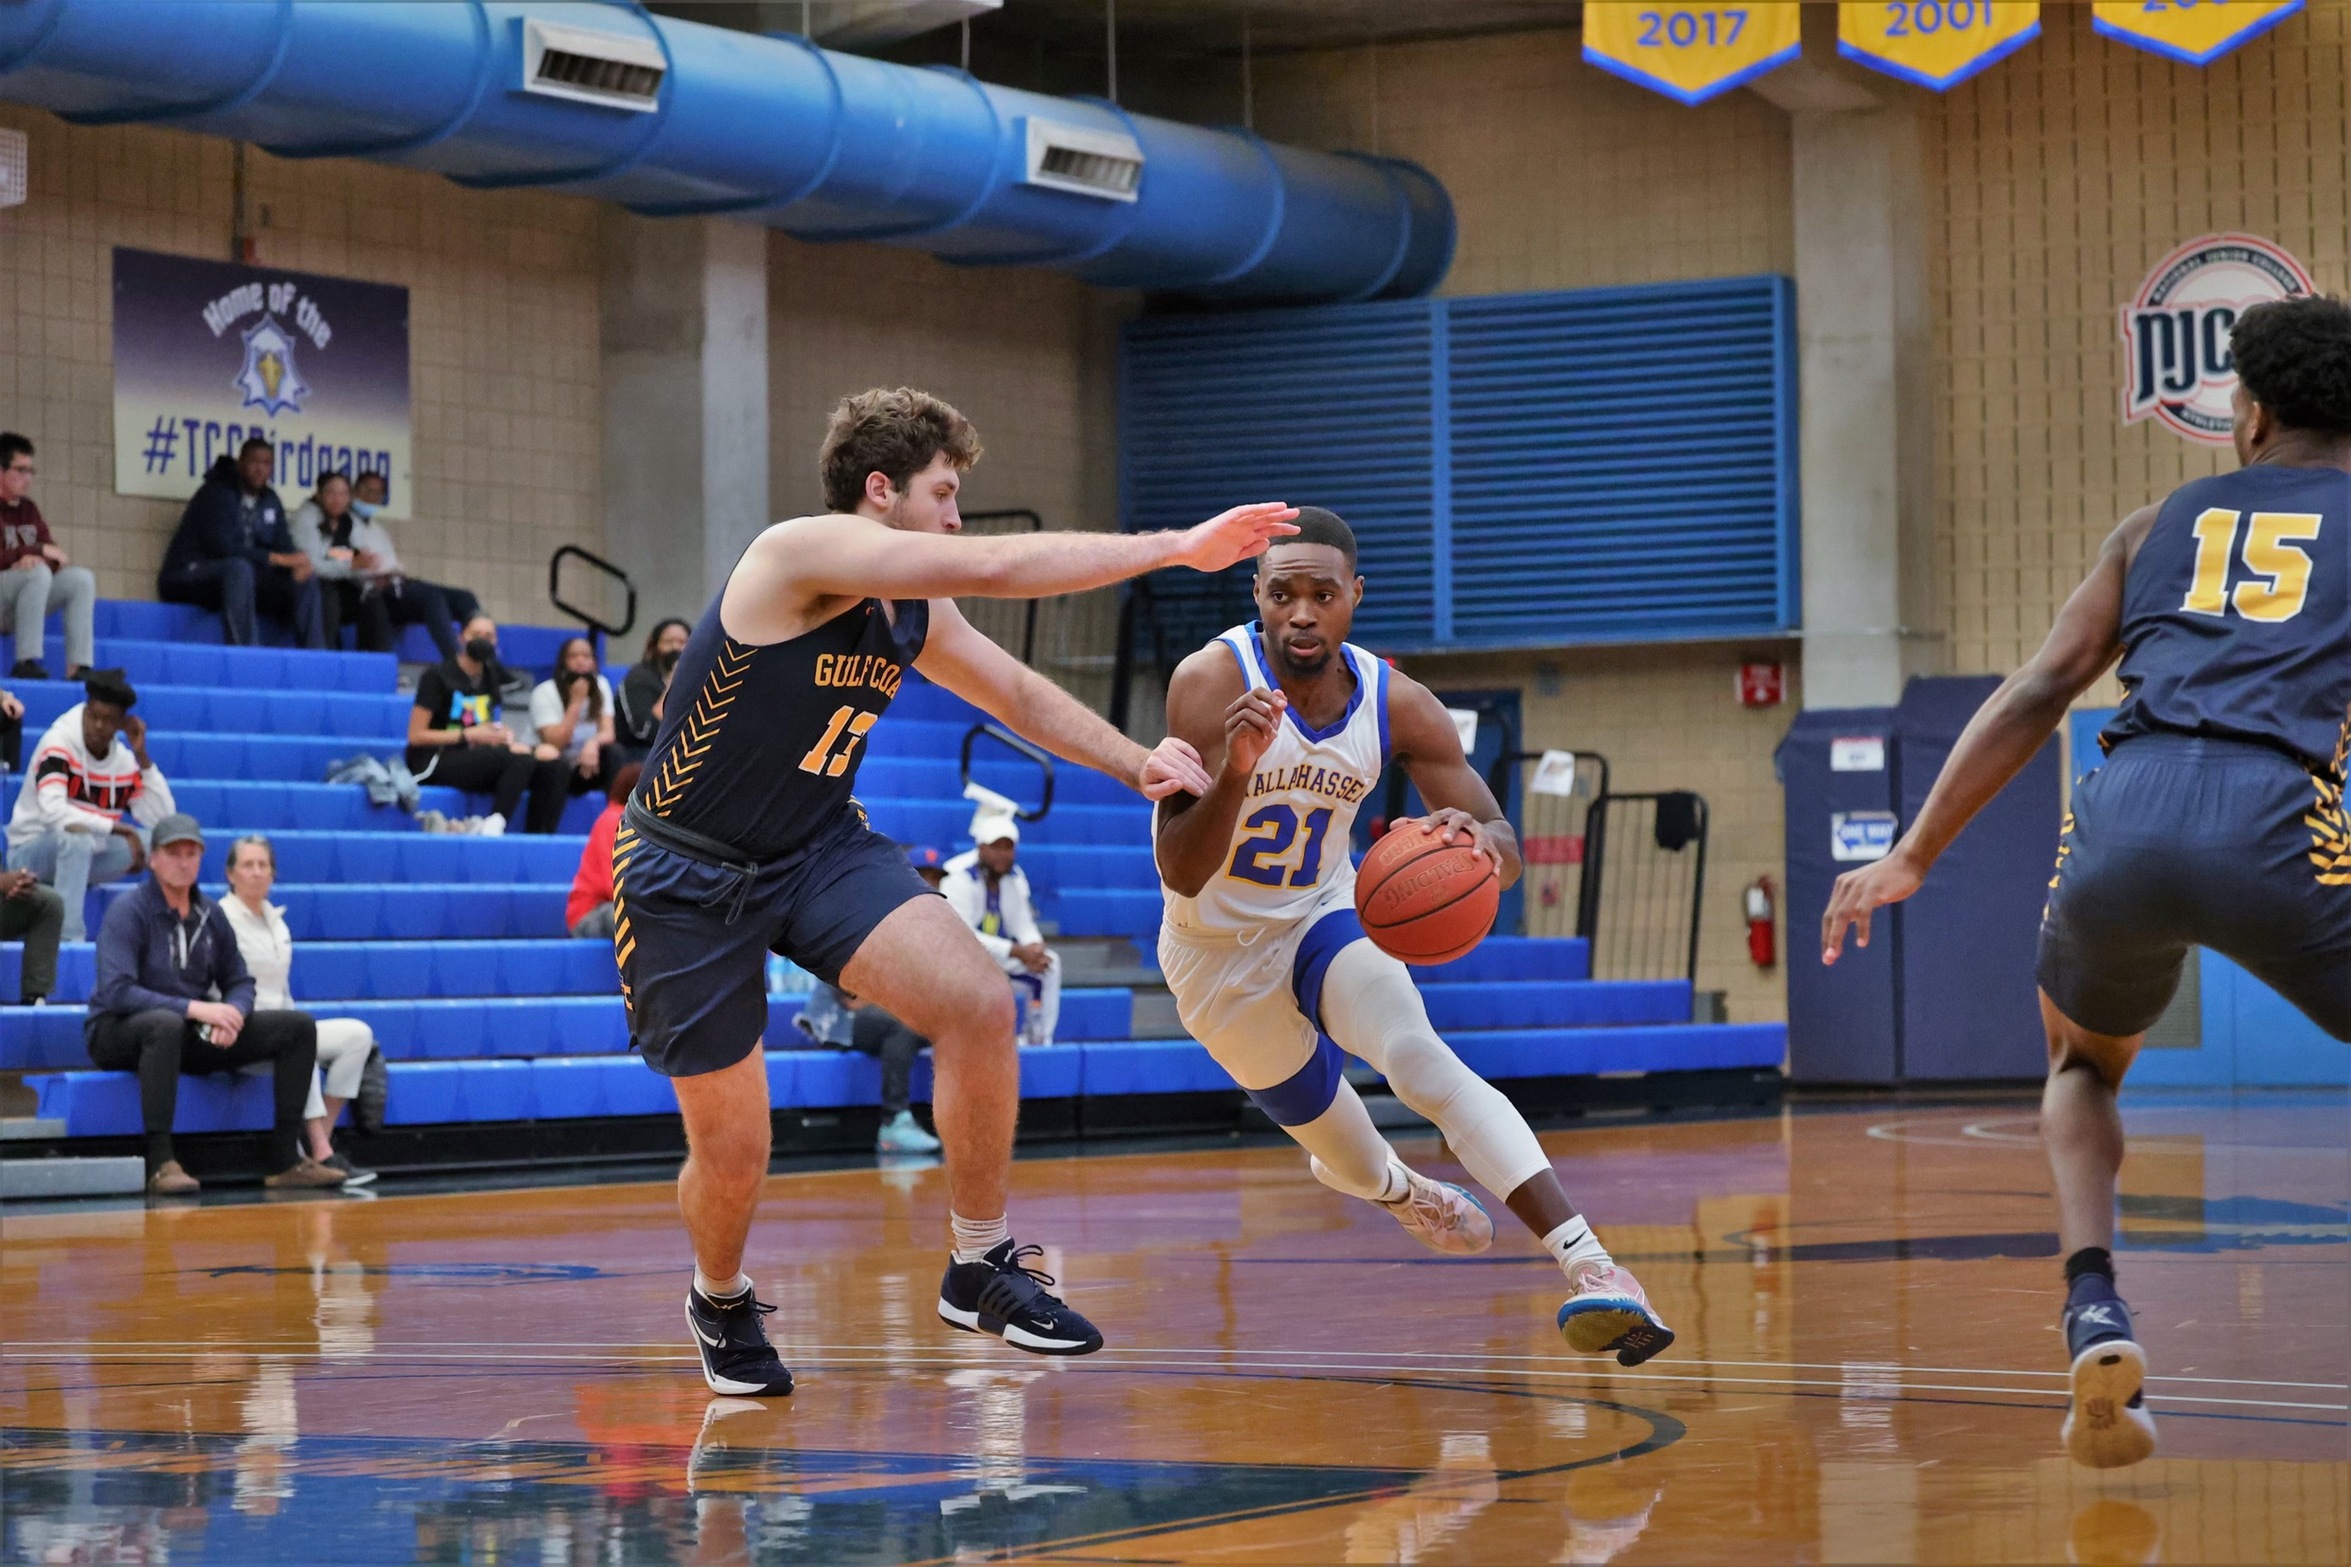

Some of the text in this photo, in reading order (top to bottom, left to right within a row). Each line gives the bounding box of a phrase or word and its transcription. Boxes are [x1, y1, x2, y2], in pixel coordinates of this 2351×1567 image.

[1637, 11, 1748, 47] 2017
[1885, 0, 1992, 36] 2001
[202, 282, 332, 349] Home of the
[2178, 507, 2323, 622] 15
[797, 704, 879, 778] 13
[1245, 764, 1366, 804] ALLAHASSE
[1225, 803, 1335, 889] 21
[1384, 851, 1475, 910] SPALDING
